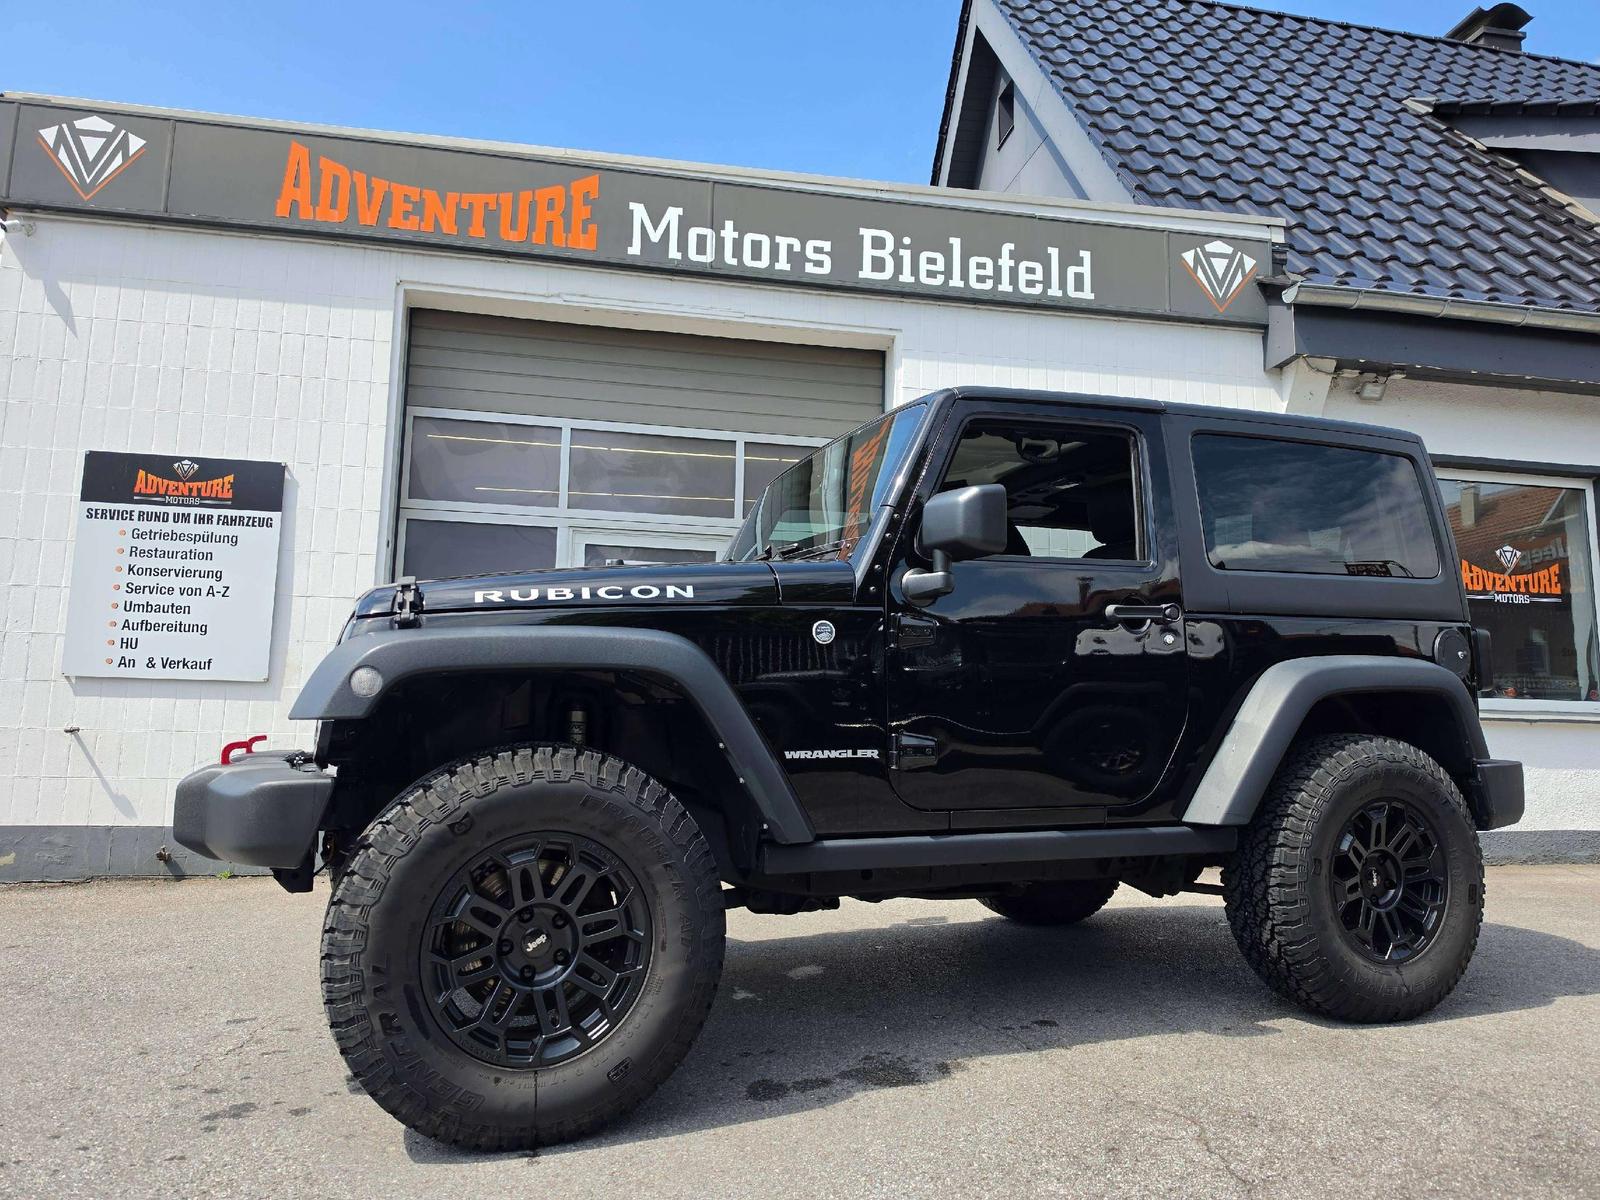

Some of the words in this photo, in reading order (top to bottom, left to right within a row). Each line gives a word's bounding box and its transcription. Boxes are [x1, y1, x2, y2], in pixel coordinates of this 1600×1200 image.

[275, 139, 600, 251] ADVENTURE
[627, 201, 832, 275] Motors
[857, 227, 1096, 300] Bielefeld
[133, 469, 235, 499] ADVENTURE
[165, 496, 200, 505] MOTORS
[86, 507, 135, 521] SERVICE
[137, 511, 169, 523] RUND
[172, 512, 191, 524] UM
[193, 514, 214, 525] IHR
[216, 514, 273, 528] FAHRZEUG
[131, 527, 239, 546] Getriebespülung
[129, 546, 213, 560] Restauration
[127, 564, 223, 582] Konservierung
[1461, 559, 1562, 595] ADVENTURE
[125, 582, 175, 596] Service
[179, 586, 202, 597] von
[206, 586, 230, 598] A-Z
[474, 584, 694, 603] RUBICON
[1494, 593, 1530, 604] MOTORS
[123, 600, 191, 615] Umbauten
[121, 619, 208, 635] Aufbereitung
[120, 637, 139, 649] HU
[117, 656, 136, 668] An
[146, 657, 156, 669] &
[160, 657, 213, 670] Verkauf
[784, 749, 880, 759] WRANGLER
[526, 934, 547, 952] Jeep
